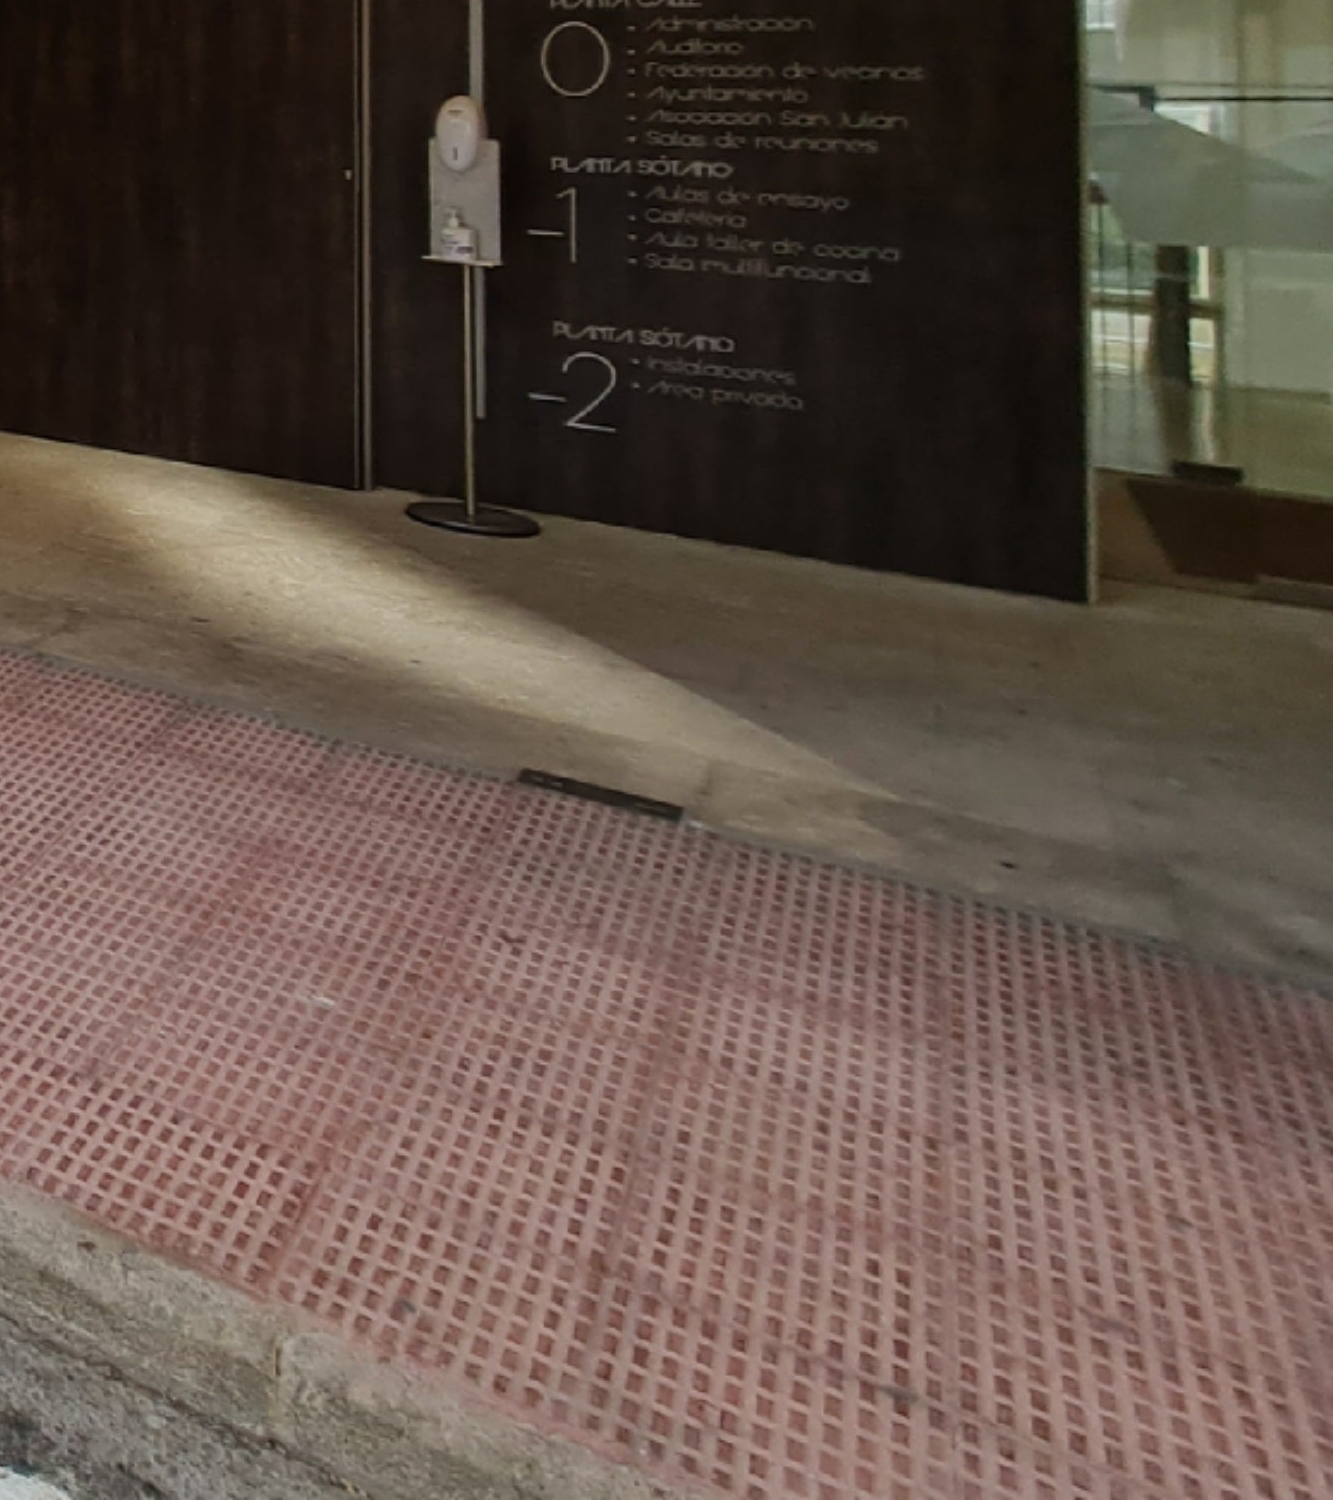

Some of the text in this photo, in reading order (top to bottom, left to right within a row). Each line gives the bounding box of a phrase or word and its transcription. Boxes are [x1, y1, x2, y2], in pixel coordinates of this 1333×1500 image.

[781, 61, 818, 80] de
[645, 85, 810, 106] Ayuntamiento
[780, 108, 831, 127] San
[644, 129, 880, 156] Salas de reuniones
[549, 156, 631, 174] PLANTA
[644, 184, 851, 212] Aulas de ensayo
[526, 185, 579, 264] -1
[644, 230, 699, 248] Aula
[772, 237, 805, 256] de
[644, 252, 695, 272] Sala
[551, 319, 634, 344] PLANTA
[528, 351, 618, 434] -2
[711, 386, 804, 412] privada
